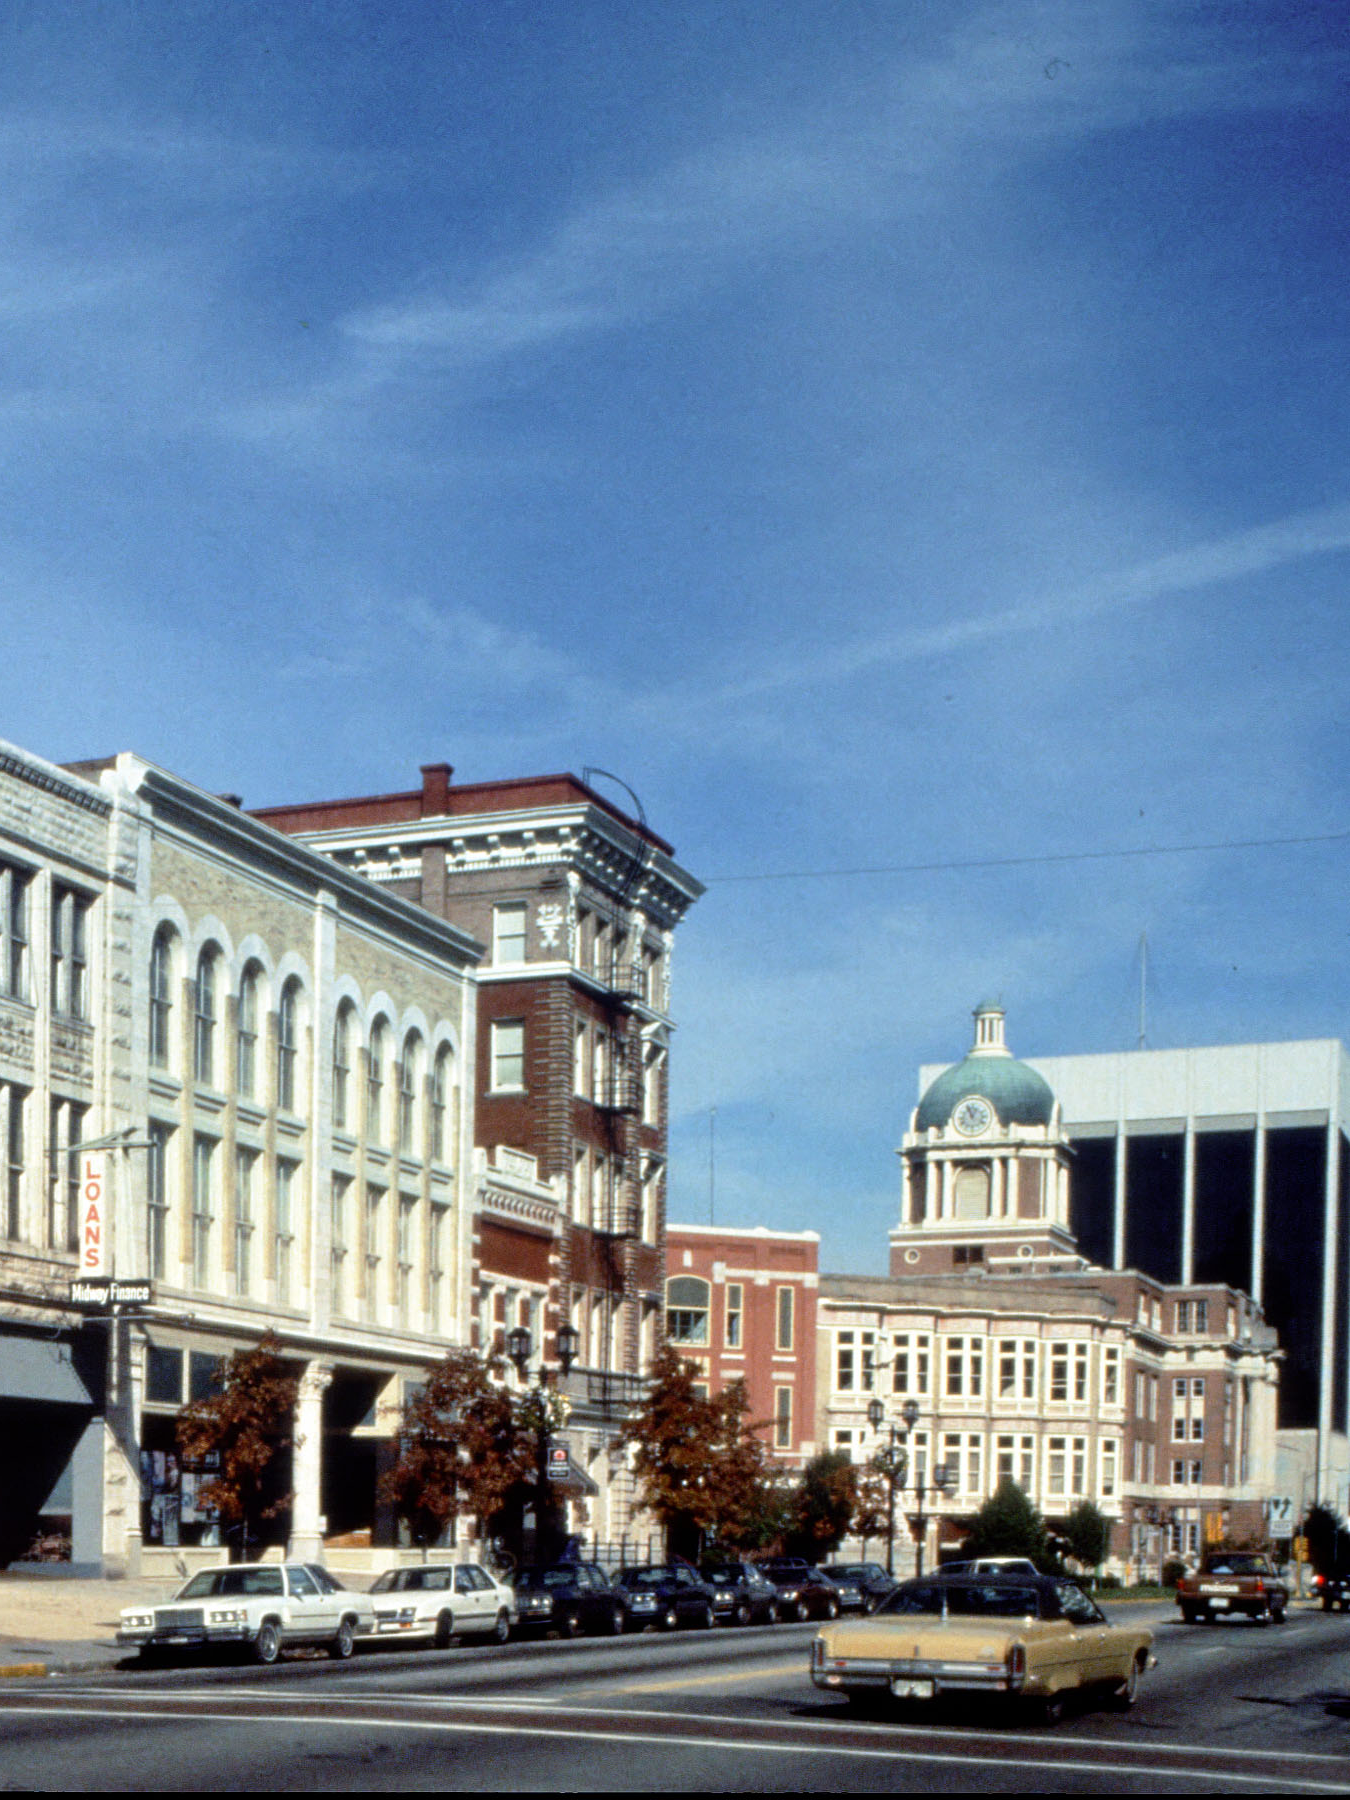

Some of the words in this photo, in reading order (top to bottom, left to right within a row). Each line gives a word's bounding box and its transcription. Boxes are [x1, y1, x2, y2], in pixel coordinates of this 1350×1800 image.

[84, 1160, 101, 1268] LOANS
[71, 1283, 110, 1305] Midway
[110, 1282, 150, 1301] Finance
